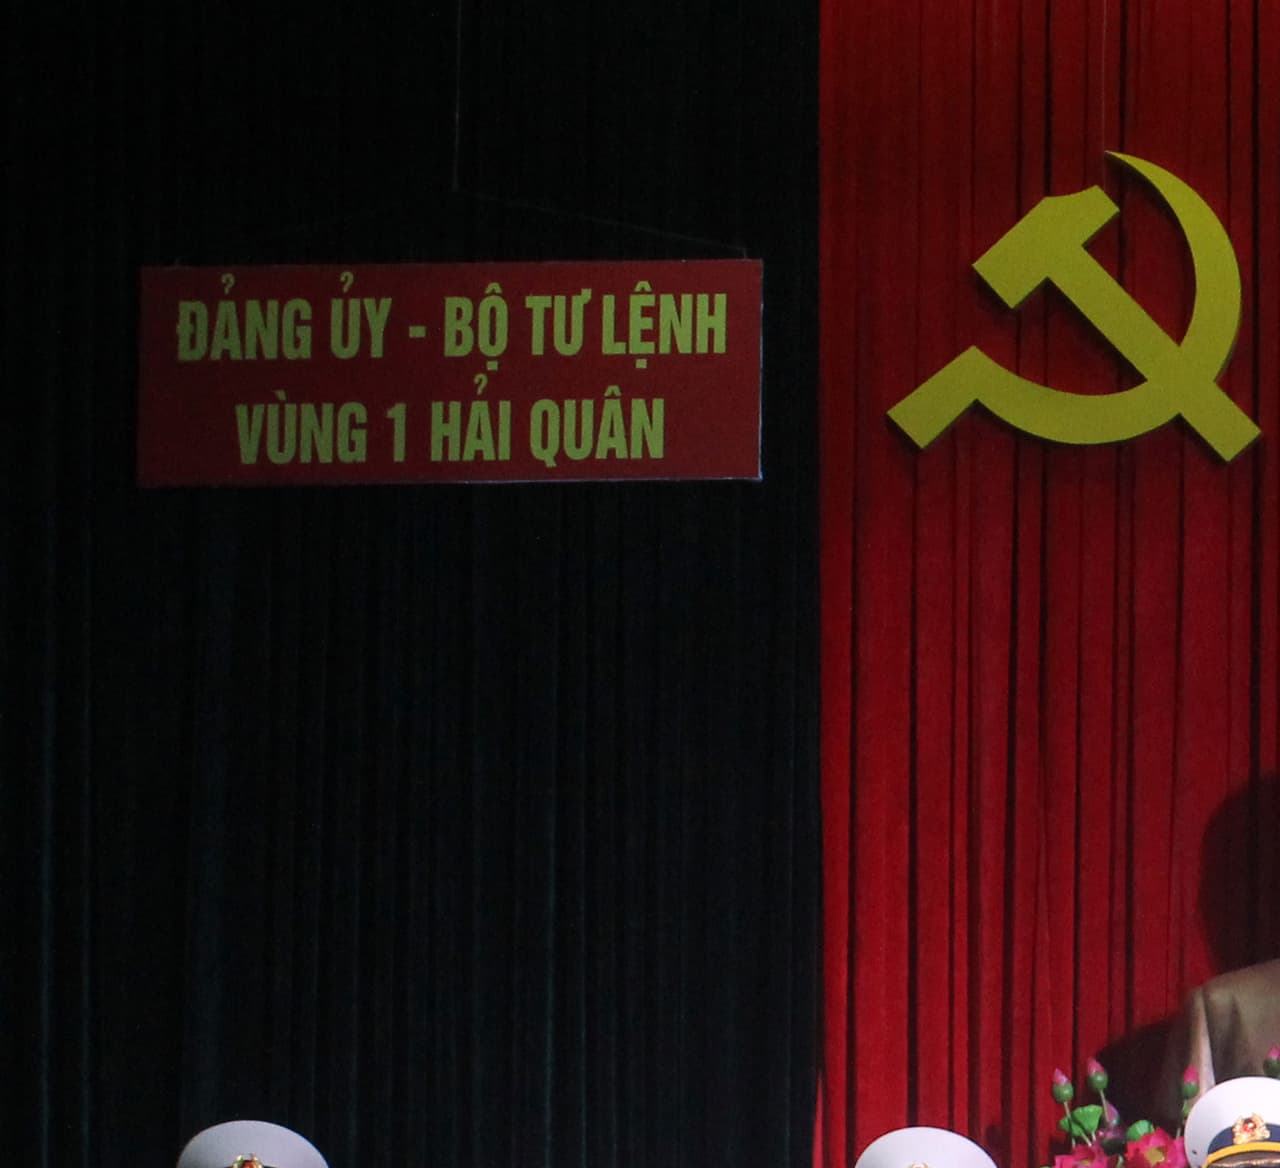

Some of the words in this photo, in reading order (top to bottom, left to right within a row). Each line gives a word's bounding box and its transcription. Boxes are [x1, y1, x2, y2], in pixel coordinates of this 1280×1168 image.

[177, 274, 312, 360] ĐẢNG
[331, 272, 392, 359] ỦY
[409, 326, 426, 338] -
[444, 282, 508, 371] BỘ
[525, 288, 592, 356] TƯ
[602, 281, 727, 369] LỆNH
[236, 390, 367, 464] VÙNG
[387, 403, 406, 462] 1
[431, 373, 511, 462] HẢI
[530, 385, 665, 468] QUÂN
